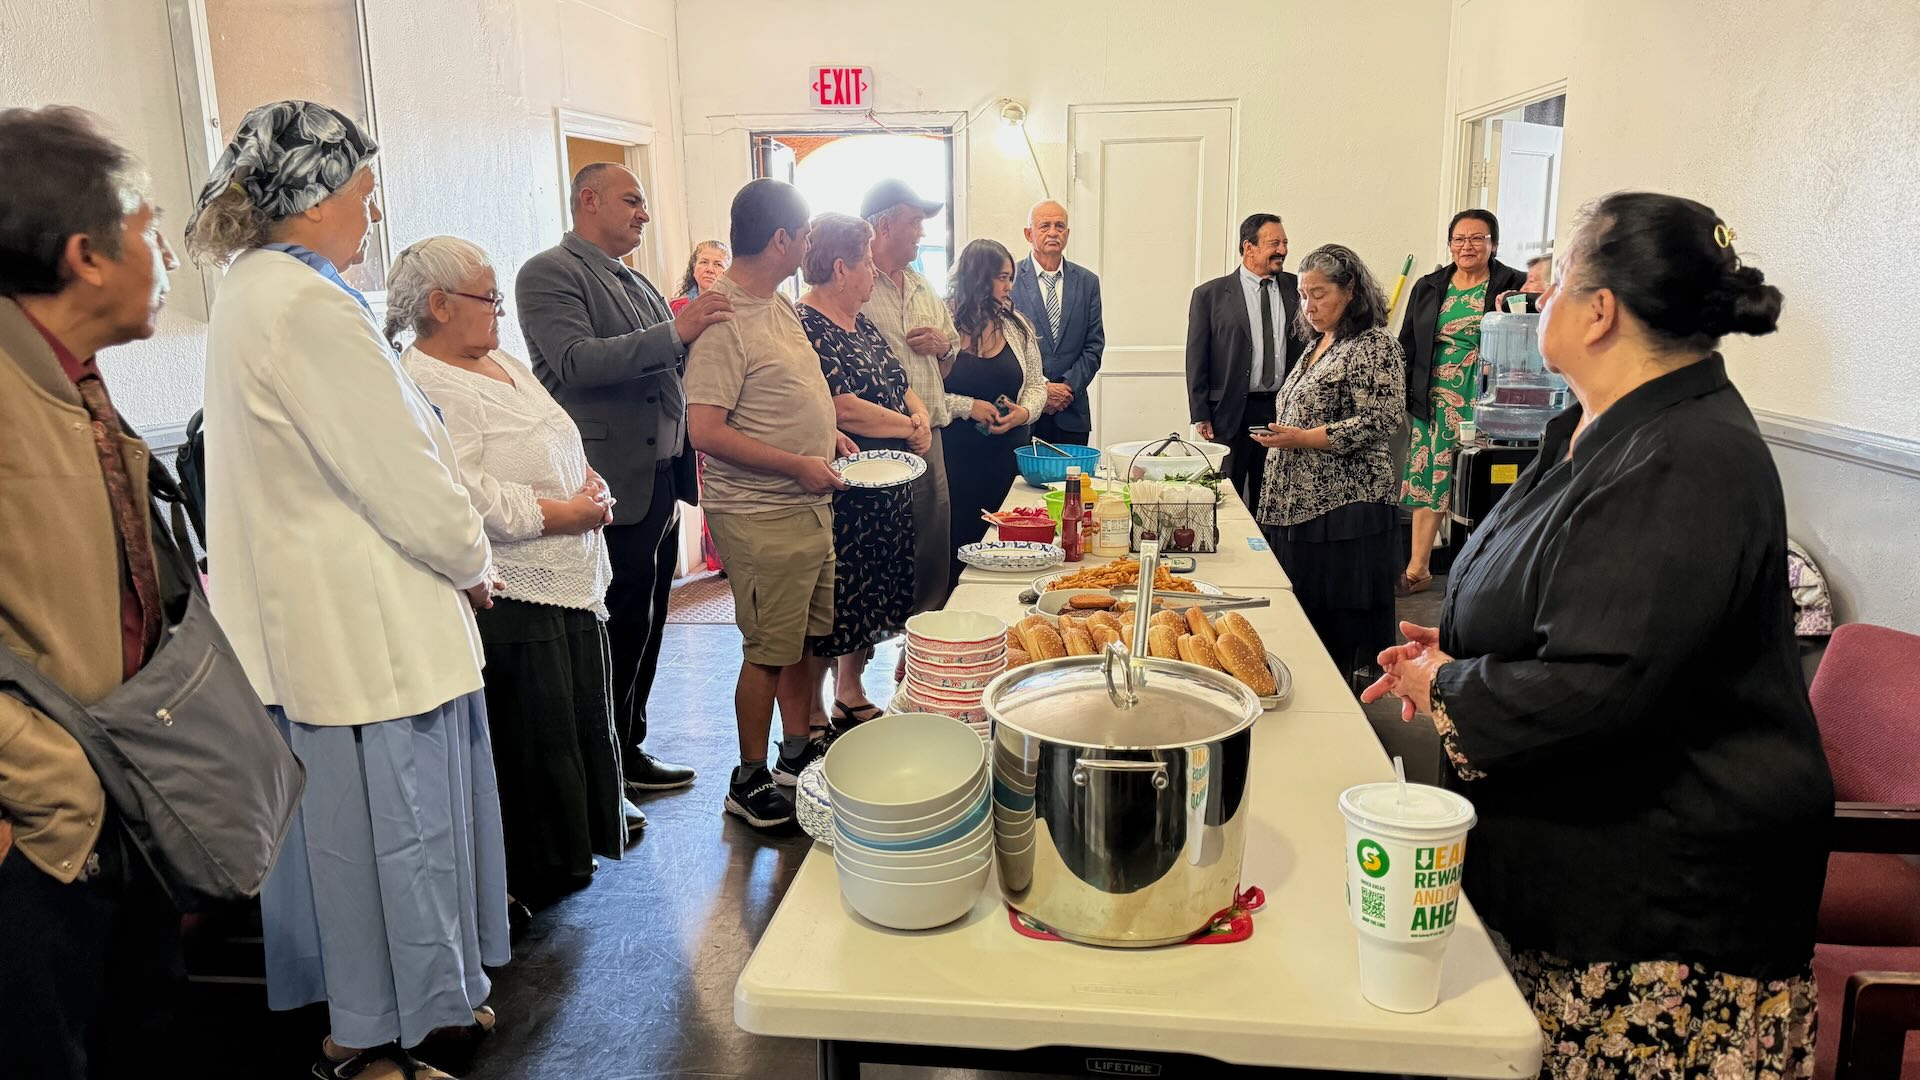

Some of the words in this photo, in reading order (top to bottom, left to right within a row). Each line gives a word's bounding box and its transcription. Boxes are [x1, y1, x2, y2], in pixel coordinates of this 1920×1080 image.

[819, 68, 863, 105] EXIT
[1413, 888, 1444, 906] AND
[1095, 1060, 1152, 1074] LIFETIME
